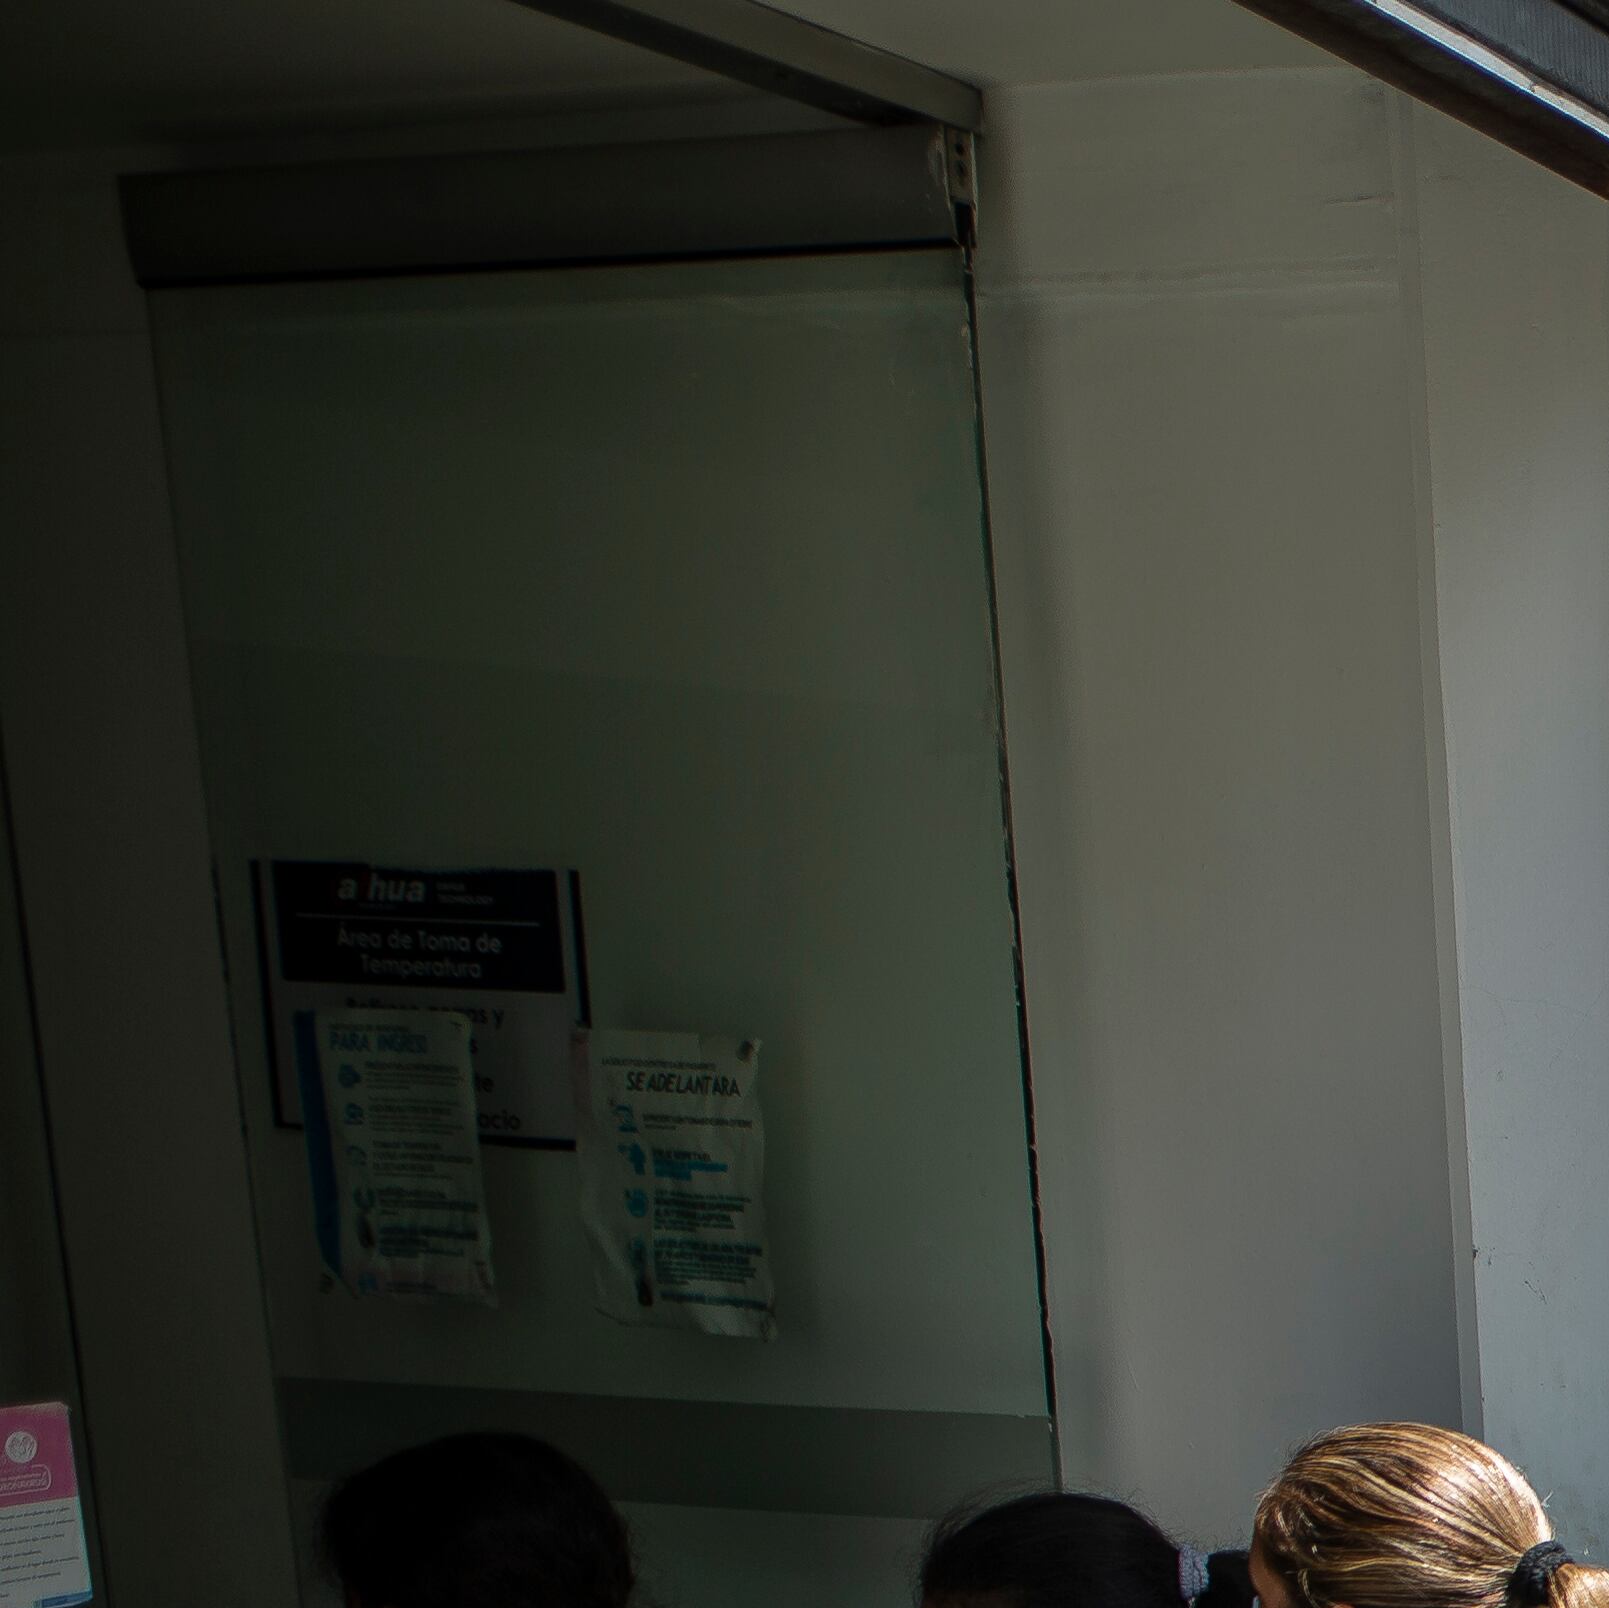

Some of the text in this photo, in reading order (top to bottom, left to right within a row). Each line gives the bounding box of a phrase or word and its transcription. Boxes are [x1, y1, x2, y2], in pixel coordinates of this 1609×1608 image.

[337, 921, 503, 954] Área de Toma de
[361, 953, 482, 979] Temperatura
[626, 1071, 646, 1091] SE
